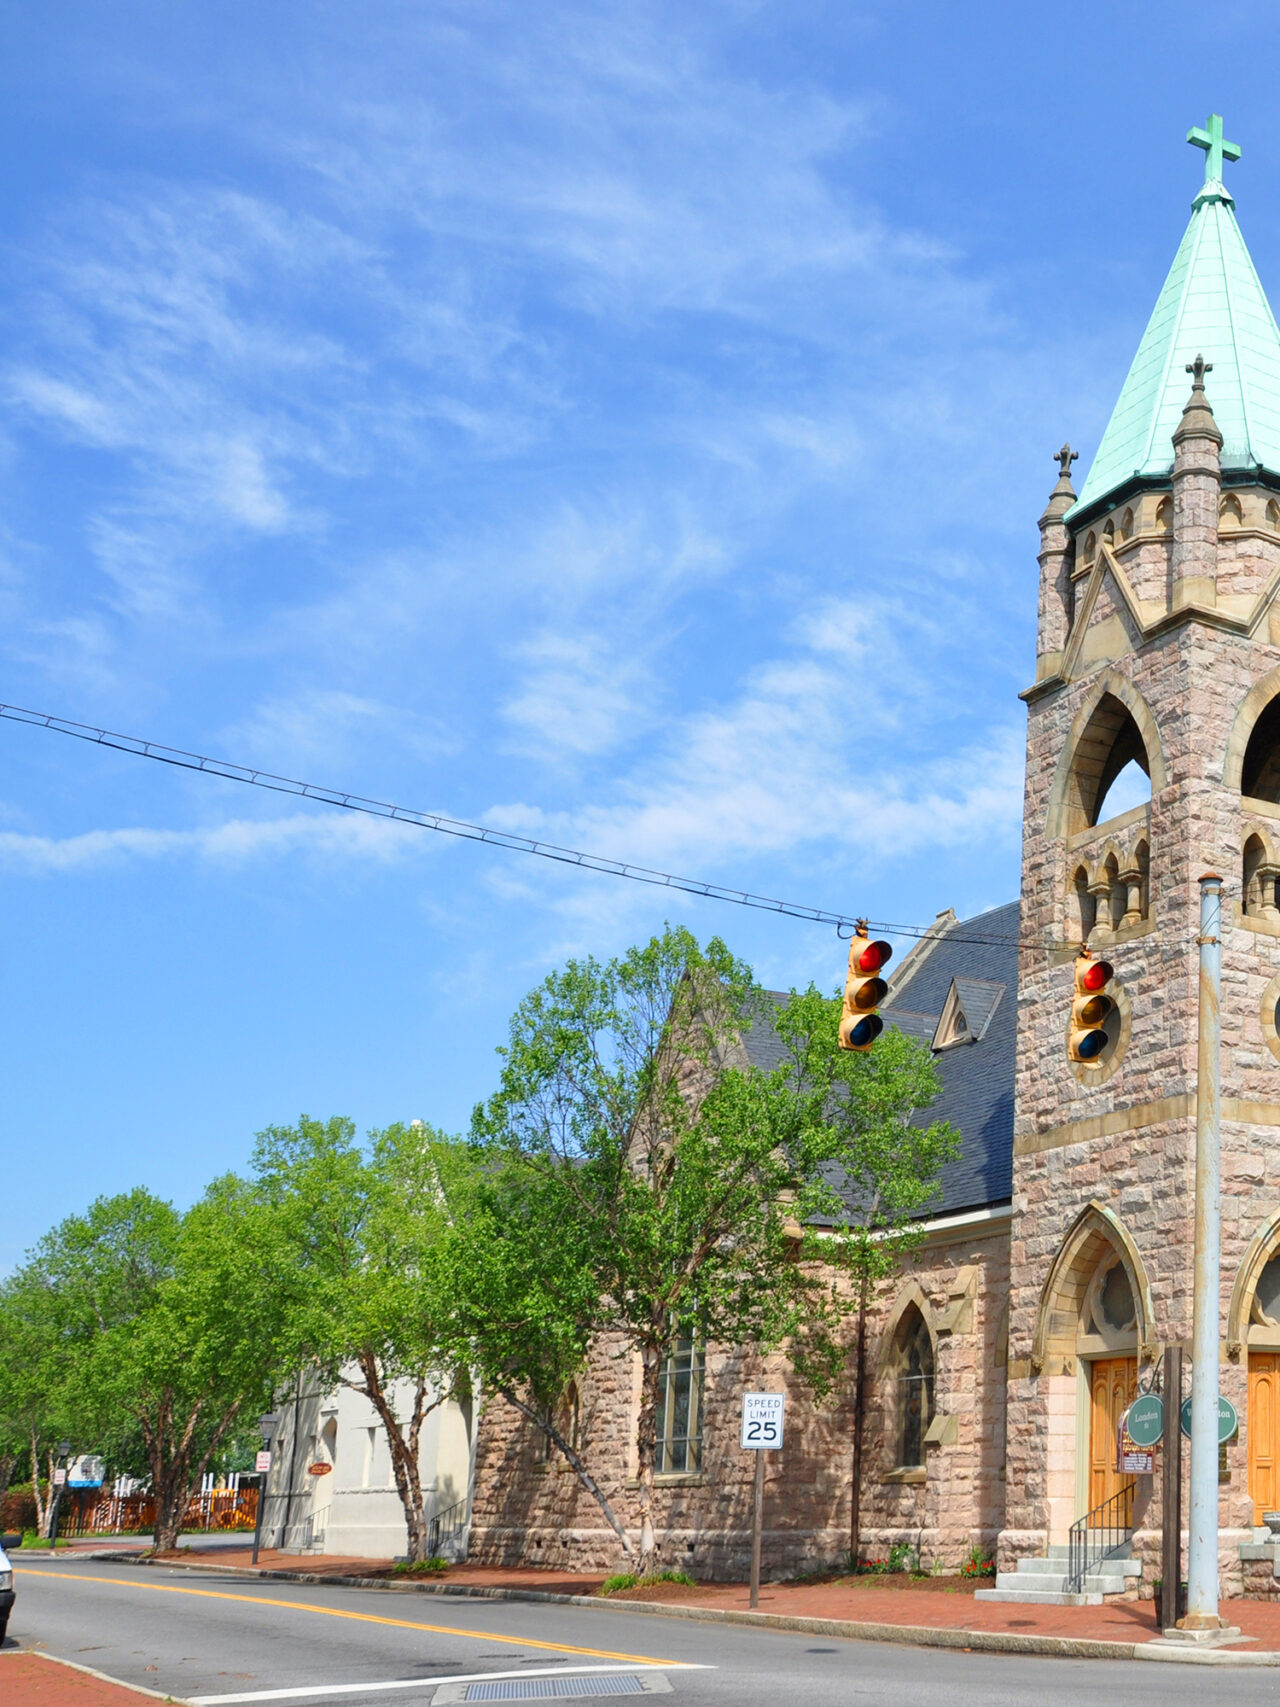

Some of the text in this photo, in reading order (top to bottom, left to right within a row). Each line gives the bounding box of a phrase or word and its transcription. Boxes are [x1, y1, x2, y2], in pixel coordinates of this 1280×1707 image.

[747, 1399, 781, 1408] SPEED
[750, 1410, 776, 1419] LIMIT
[1134, 1411, 1158, 1423] London
[747, 1421, 777, 1441] 25
